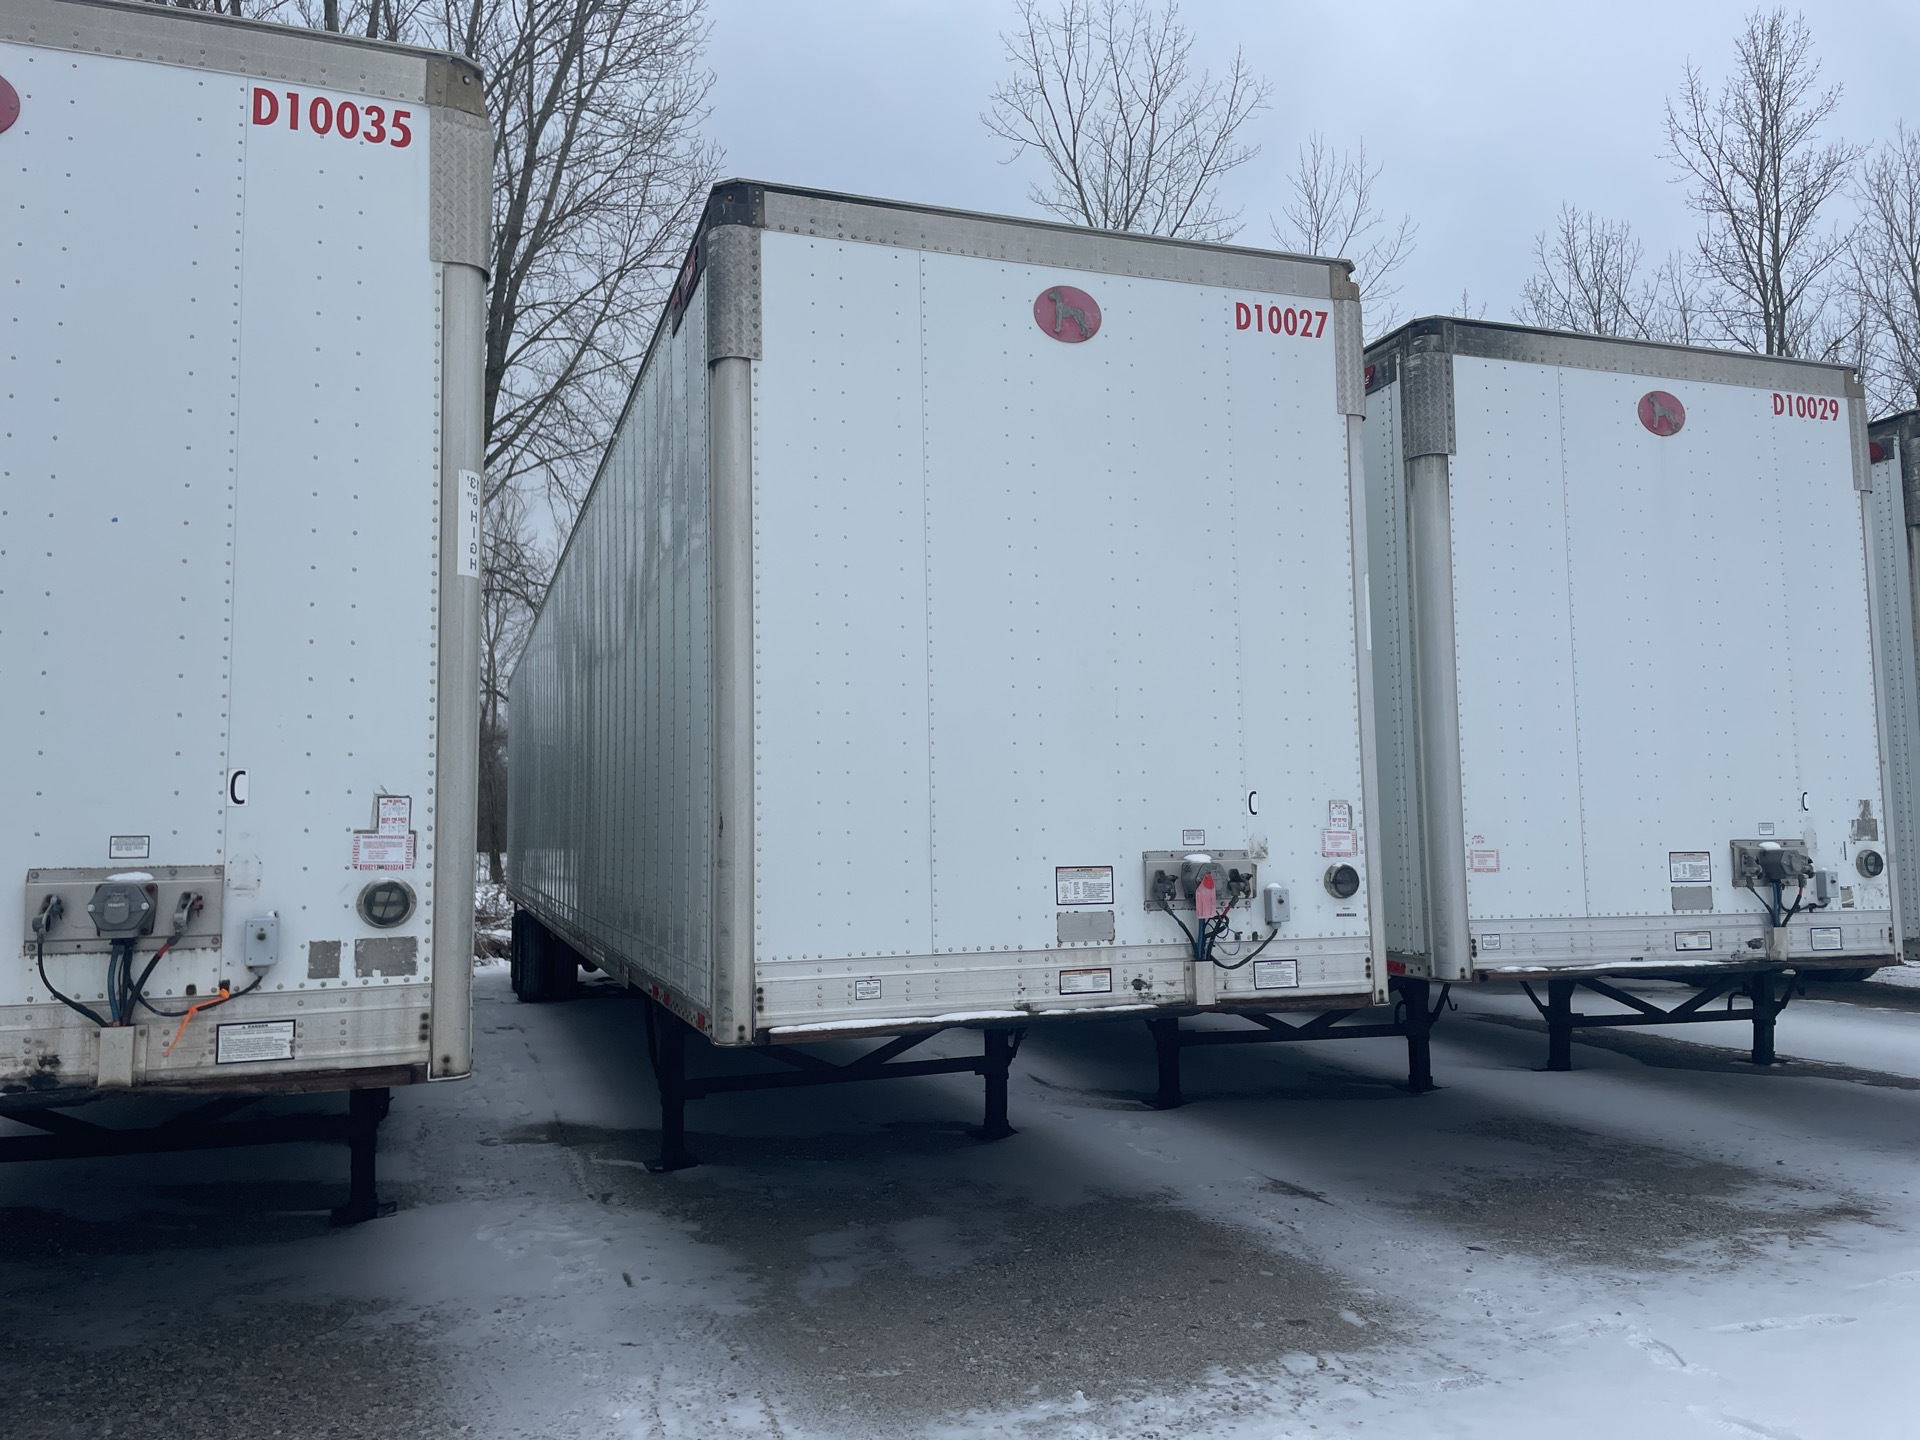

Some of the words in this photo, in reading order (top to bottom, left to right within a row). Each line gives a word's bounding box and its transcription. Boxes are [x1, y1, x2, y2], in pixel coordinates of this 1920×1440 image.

[253, 87, 412, 148] D10035
[1235, 302, 1329, 338] D10027
[1773, 393, 1839, 421] D10029
[230, 770, 246, 804] C
[1248, 790, 1258, 815] C
[1802, 792, 1809, 811] C
